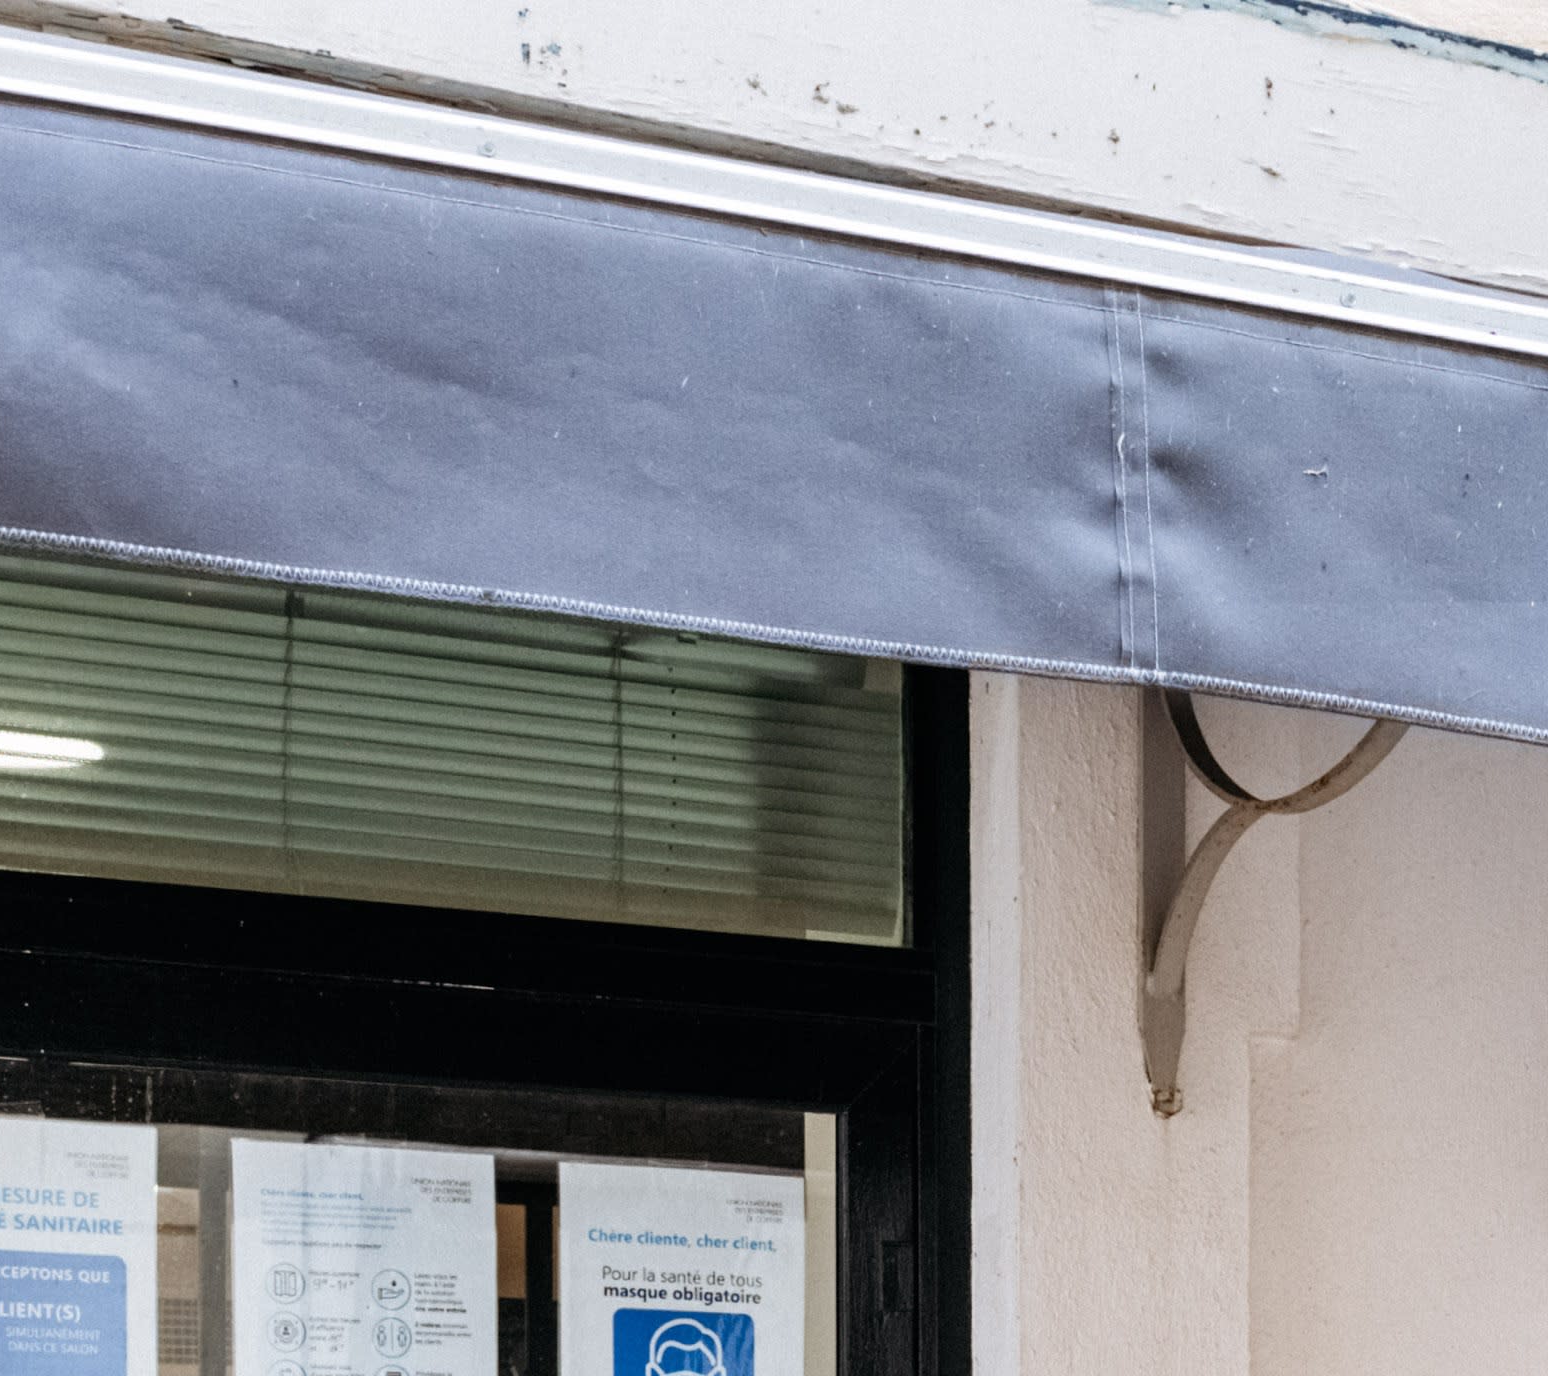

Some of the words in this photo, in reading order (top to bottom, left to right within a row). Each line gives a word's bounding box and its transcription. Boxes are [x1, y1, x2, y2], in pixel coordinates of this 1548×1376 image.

[73, 1190, 100, 1209] DE
[14, 1213, 123, 1236] SANITAIRE
[588, 1228, 633, 1243] Chère
[637, 1231, 691, 1249] cliente,
[696, 1234, 729, 1249] cher
[733, 1236, 777, 1253] client,
[78, 1270, 111, 1284] QUE
[602, 1266, 637, 1281] Pour
[642, 1267, 655, 1283] la
[660, 1270, 701, 1285] santé
[706, 1271, 725, 1286] de
[730, 1273, 763, 1288] tous
[603, 1286, 667, 1304] masque
[673, 1287, 762, 1306] obligatoire
